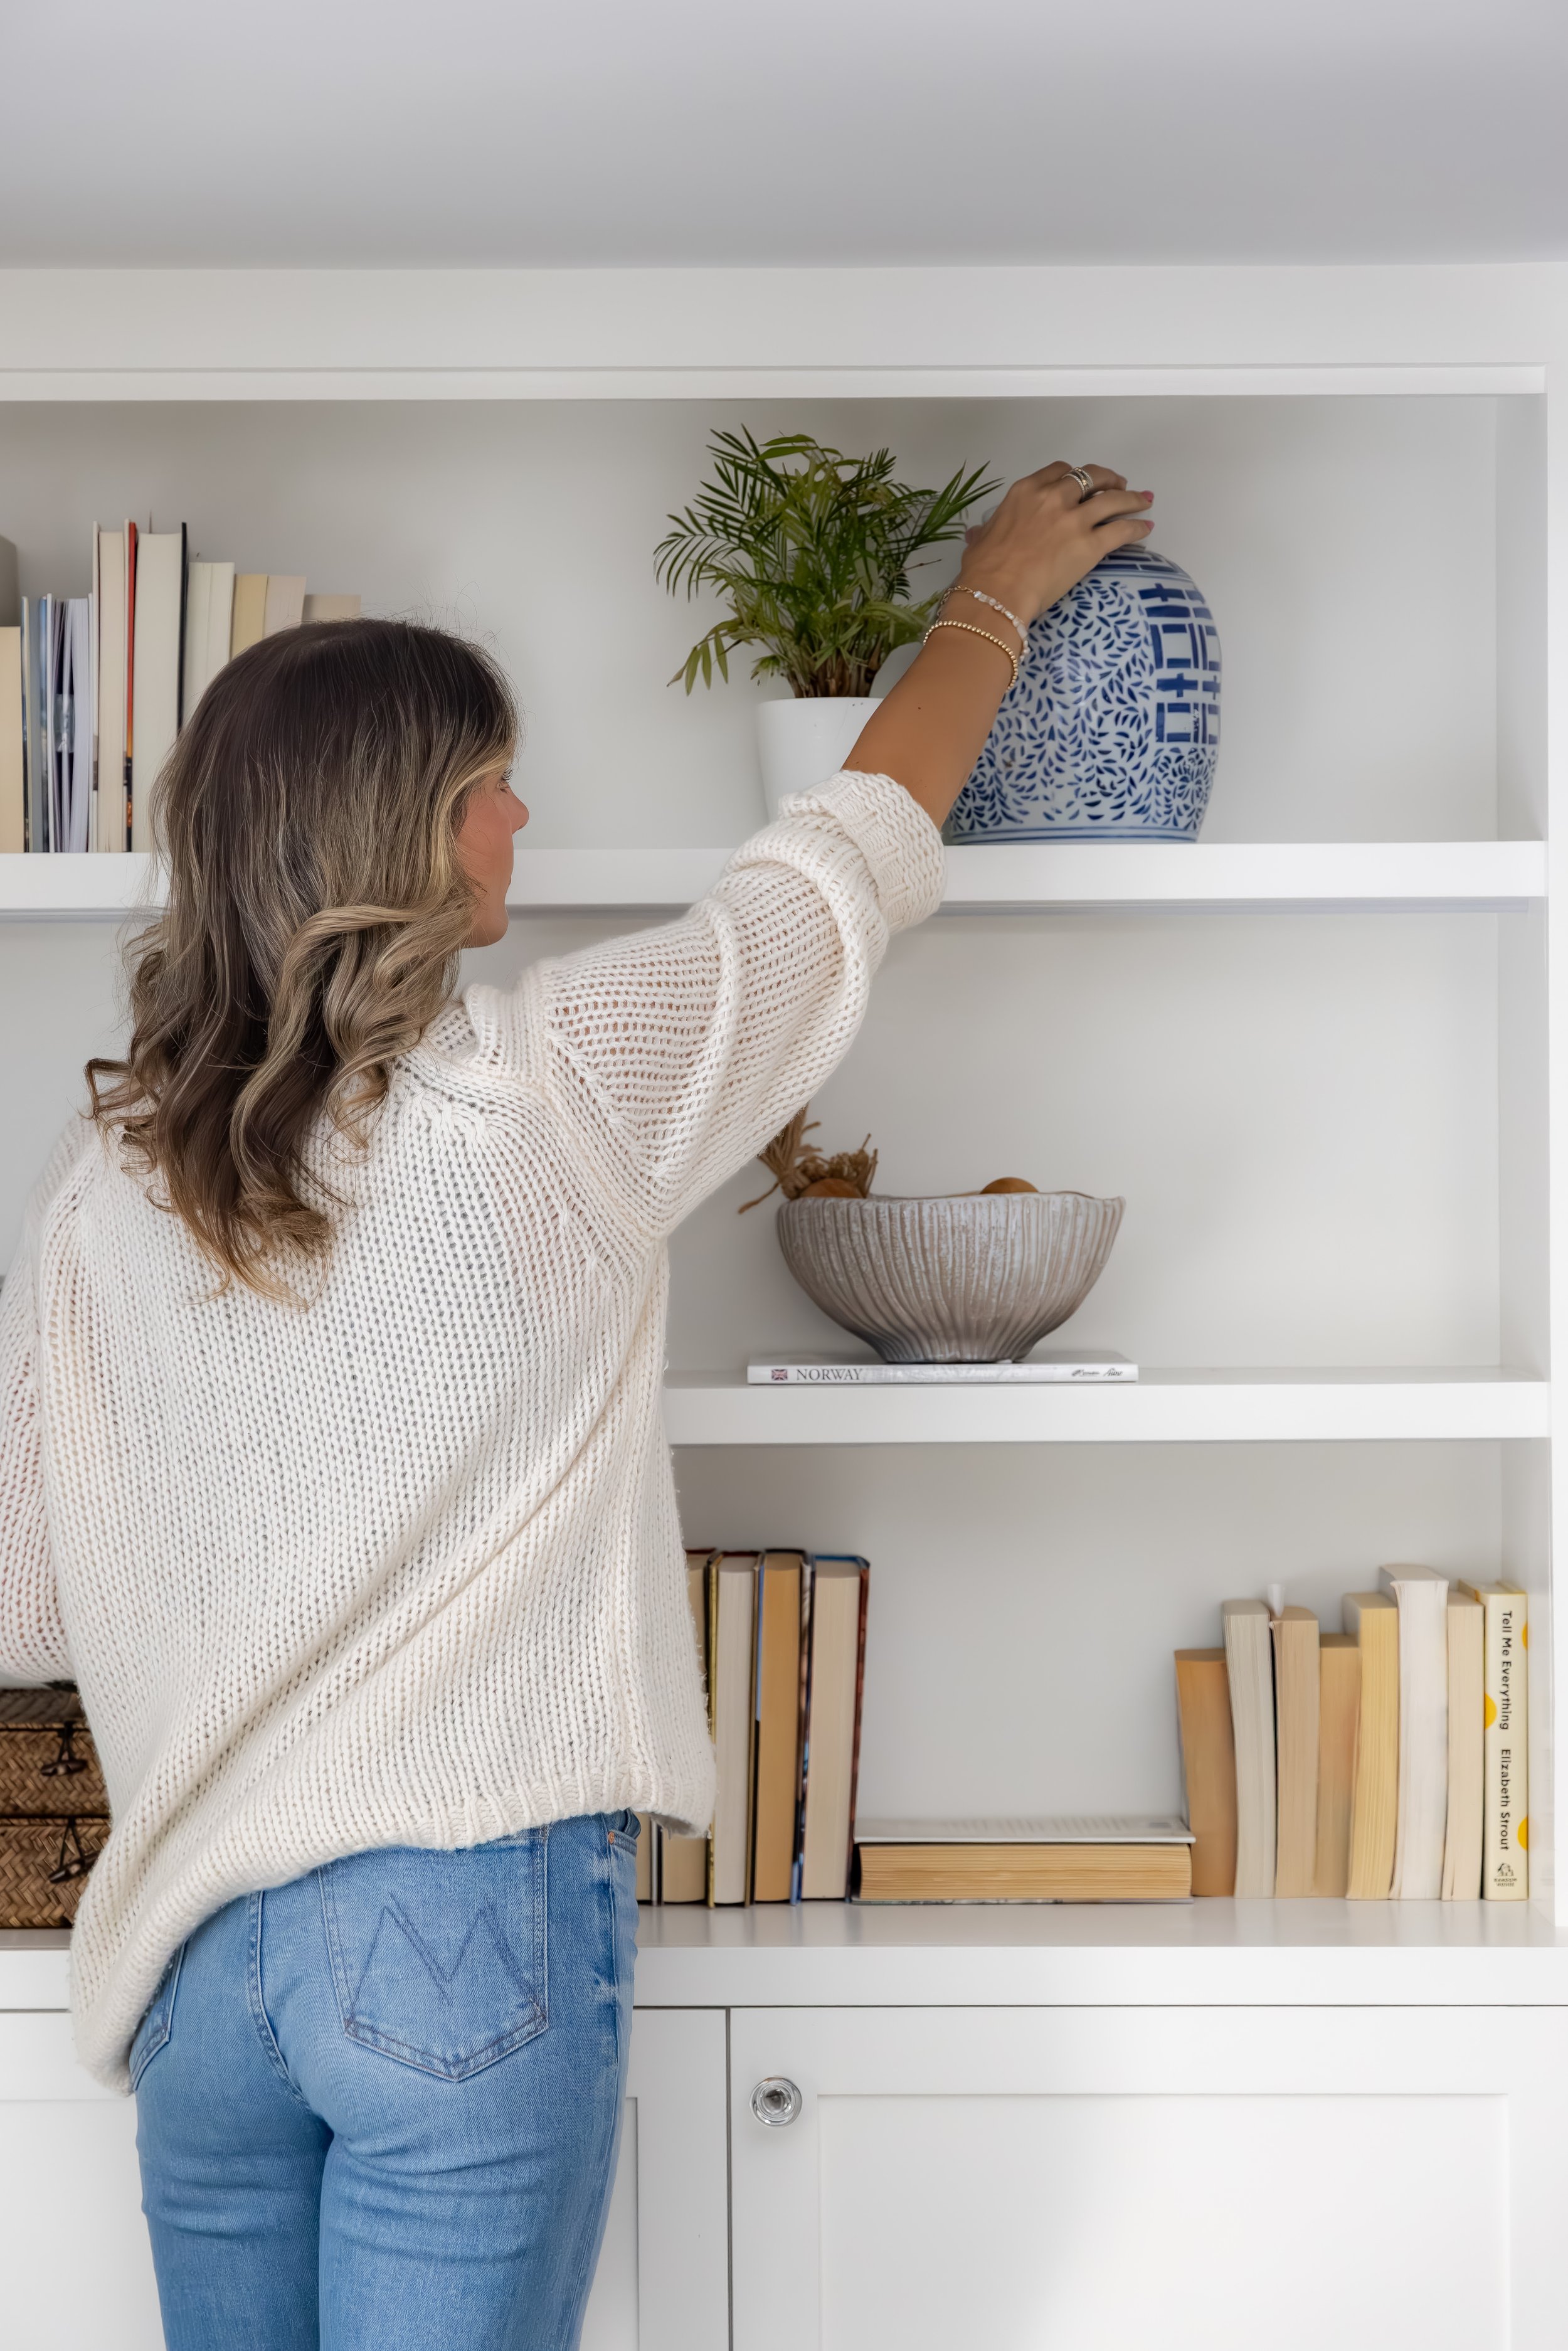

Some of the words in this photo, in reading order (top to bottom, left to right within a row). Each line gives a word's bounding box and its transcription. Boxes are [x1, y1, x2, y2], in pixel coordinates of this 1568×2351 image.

[797, 1368, 862, 1381] NORWAY
[1502, 1610, 1512, 1633] Tell
[1502, 1638, 1512, 1656] Me
[1500, 1661, 1512, 1730] Everything
[1501, 1749, 1512, 1807] Elizabeth
[1500, 1812, 1510, 1850] Strout
